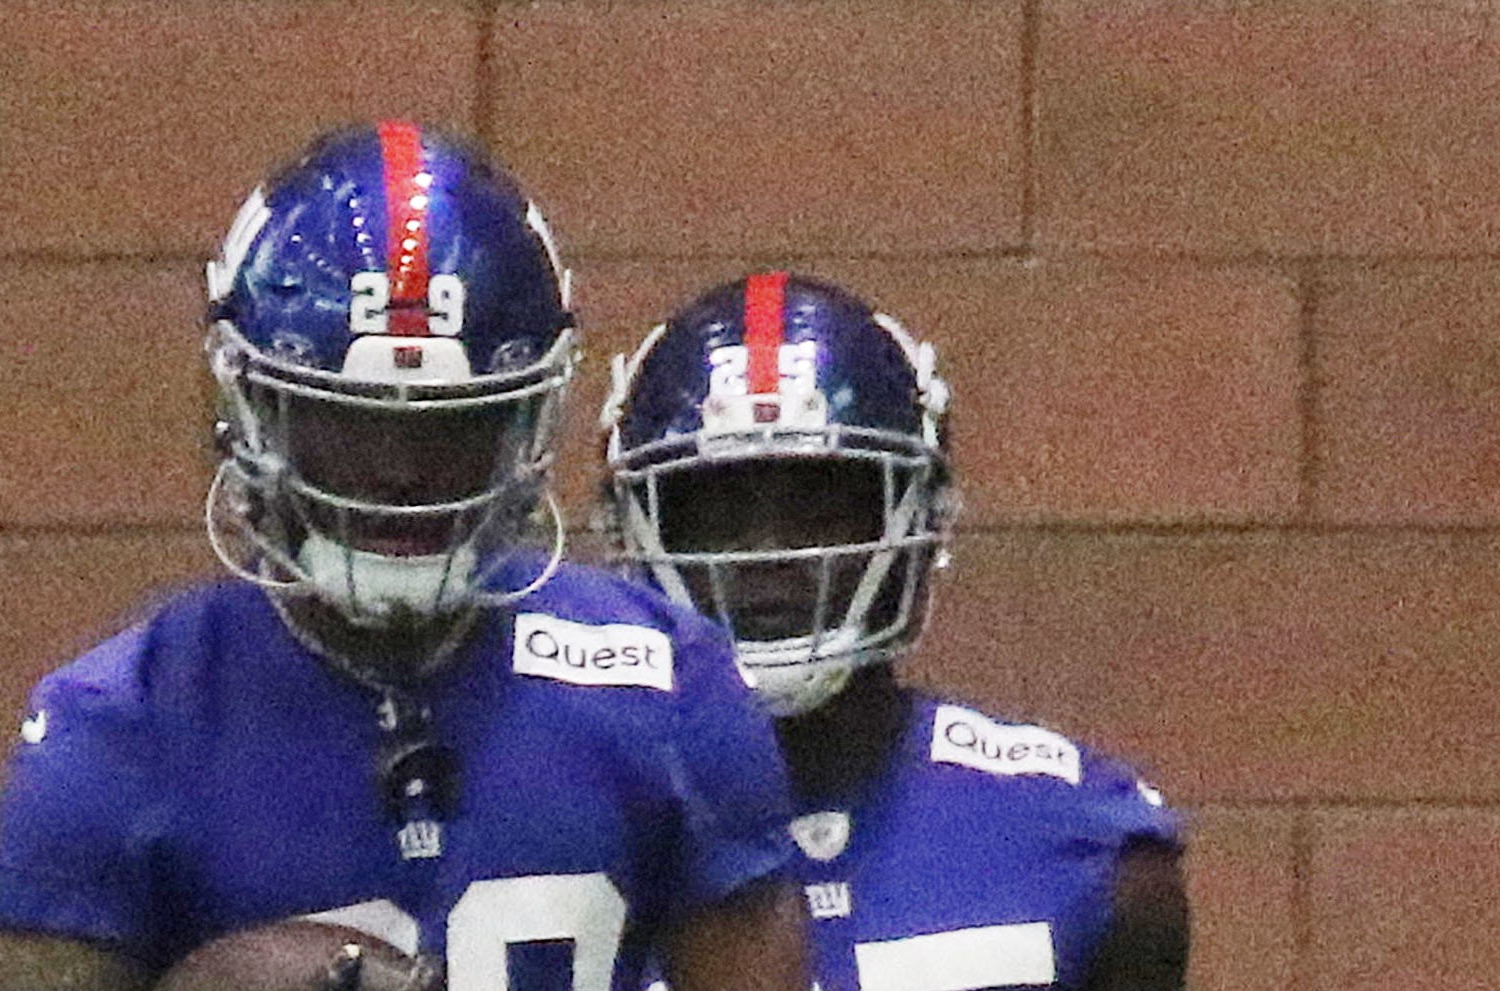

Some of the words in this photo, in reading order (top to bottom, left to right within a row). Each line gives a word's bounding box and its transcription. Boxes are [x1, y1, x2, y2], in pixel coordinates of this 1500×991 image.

[350, 271, 464, 336] 29
[709, 340, 817, 398] 25
[525, 629, 659, 670] Quest
[943, 720, 1064, 763] Quest
